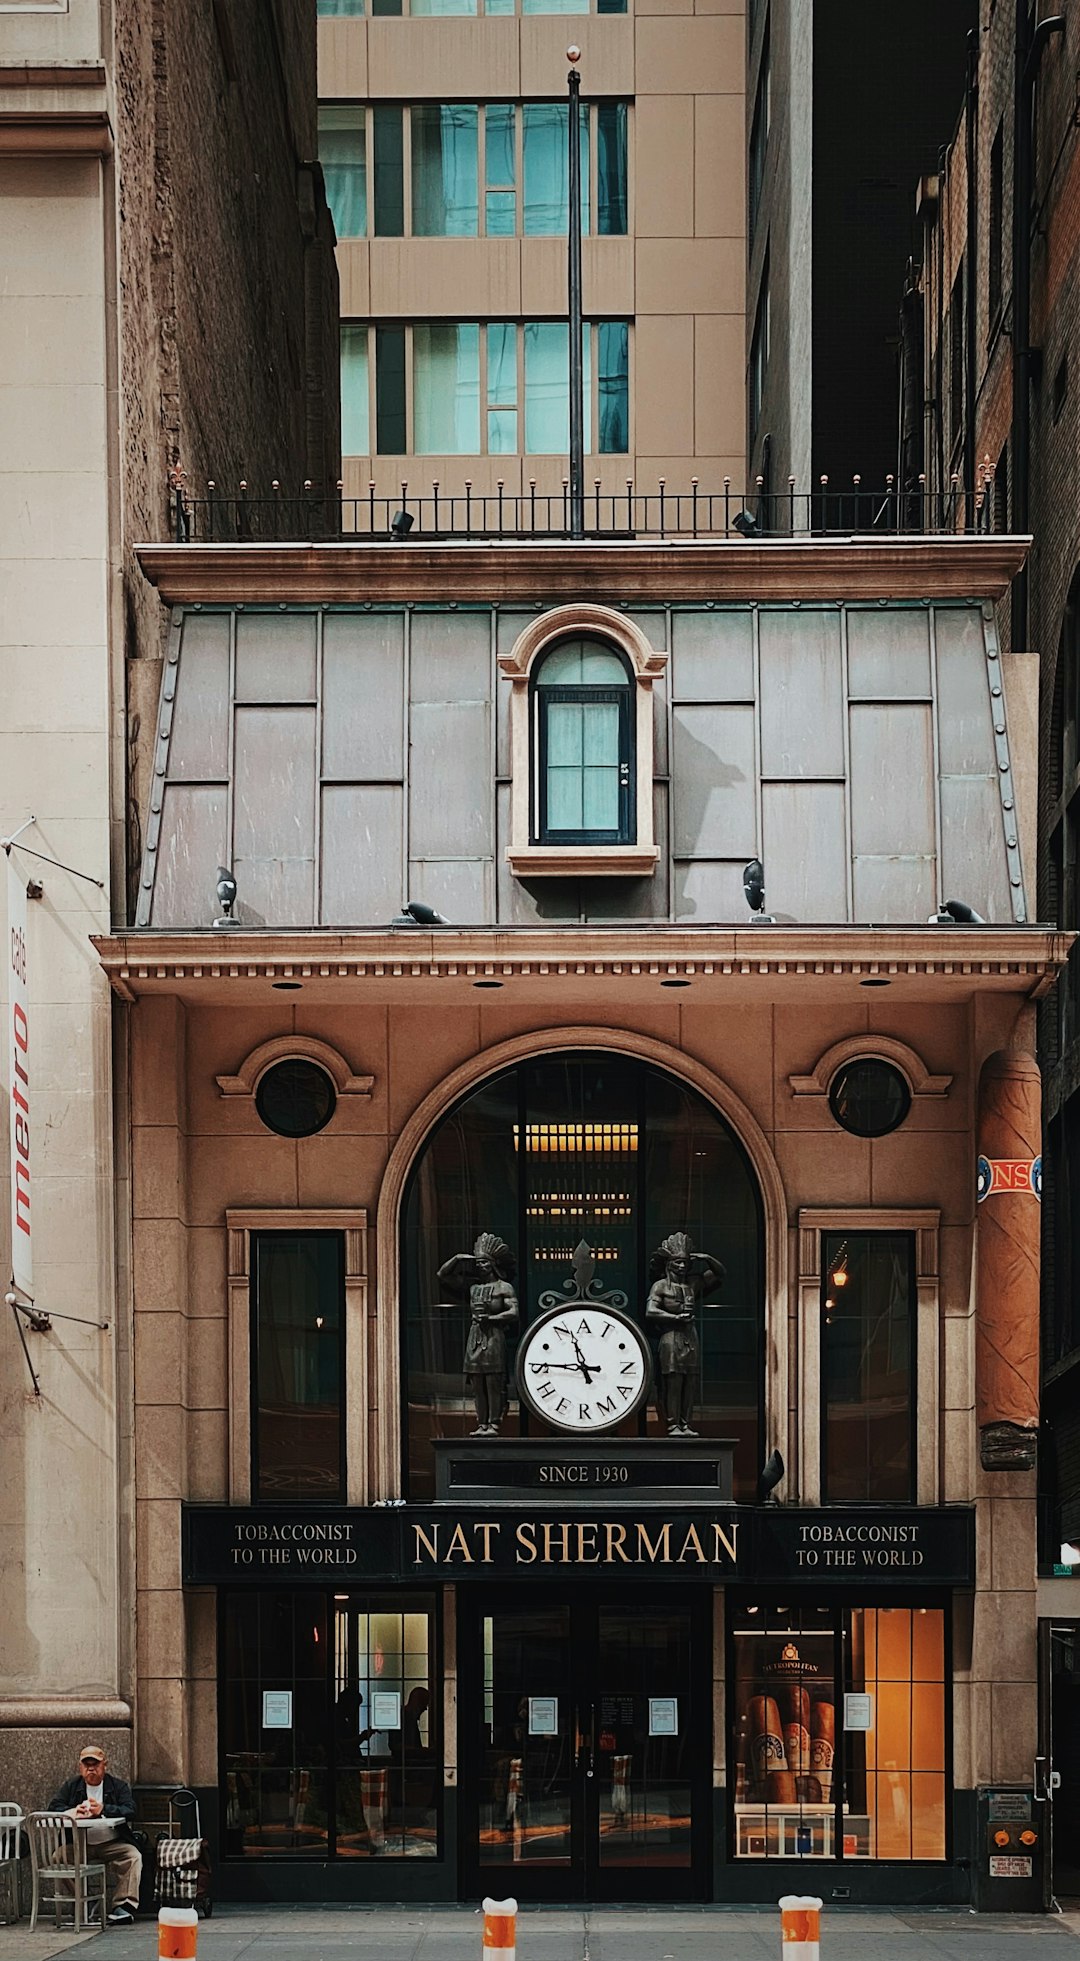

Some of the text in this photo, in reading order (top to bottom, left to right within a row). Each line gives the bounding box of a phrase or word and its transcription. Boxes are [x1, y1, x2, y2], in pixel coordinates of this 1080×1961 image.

[11, 926, 27, 985] café
[12, 1002, 31, 1236] metro
[993, 1164, 1029, 1187] NS
[552, 1318, 615, 1341] NAT
[530, 1361, 637, 1420] SHERMAN
[539, 1466, 628, 1482] SINCE 1930
[234, 1523, 354, 1541] TOBACCONIST
[411, 1522, 740, 1564] NAT SHERMAN
[799, 1525, 919, 1543] TOBACCONIST
[230, 1547, 358, 1565] TO THE WORLD
[796, 1549, 924, 1567] TO THE WORLD
